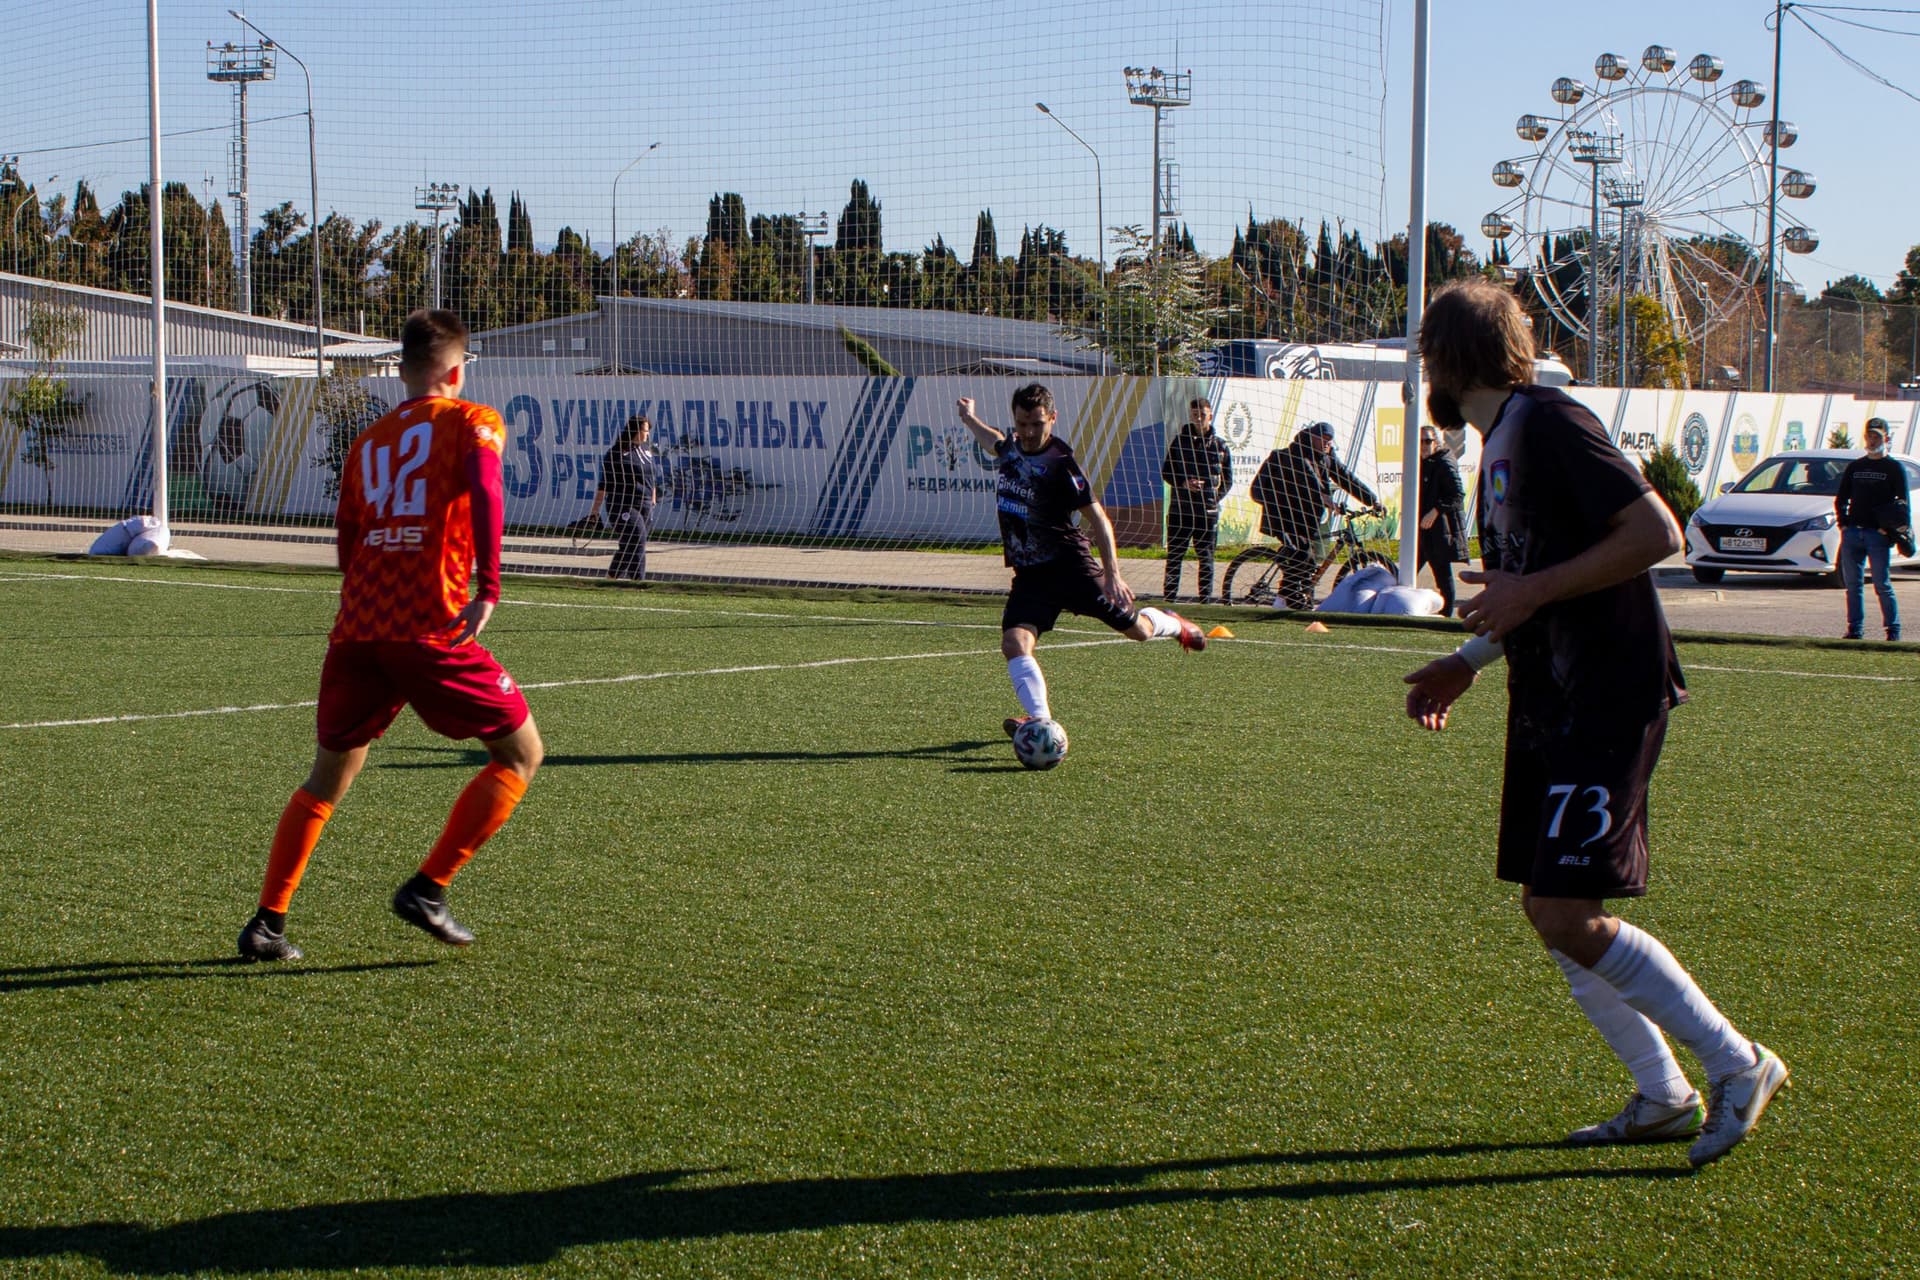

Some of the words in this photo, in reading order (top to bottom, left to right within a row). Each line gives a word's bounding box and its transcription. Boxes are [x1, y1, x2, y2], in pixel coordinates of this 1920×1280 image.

[361, 421, 433, 519] 42
[503, 395, 543, 498] 3
[1620, 431, 1656, 450] PALETA
[363, 526, 423, 547] EUS
[1547, 784, 1612, 848] 73
